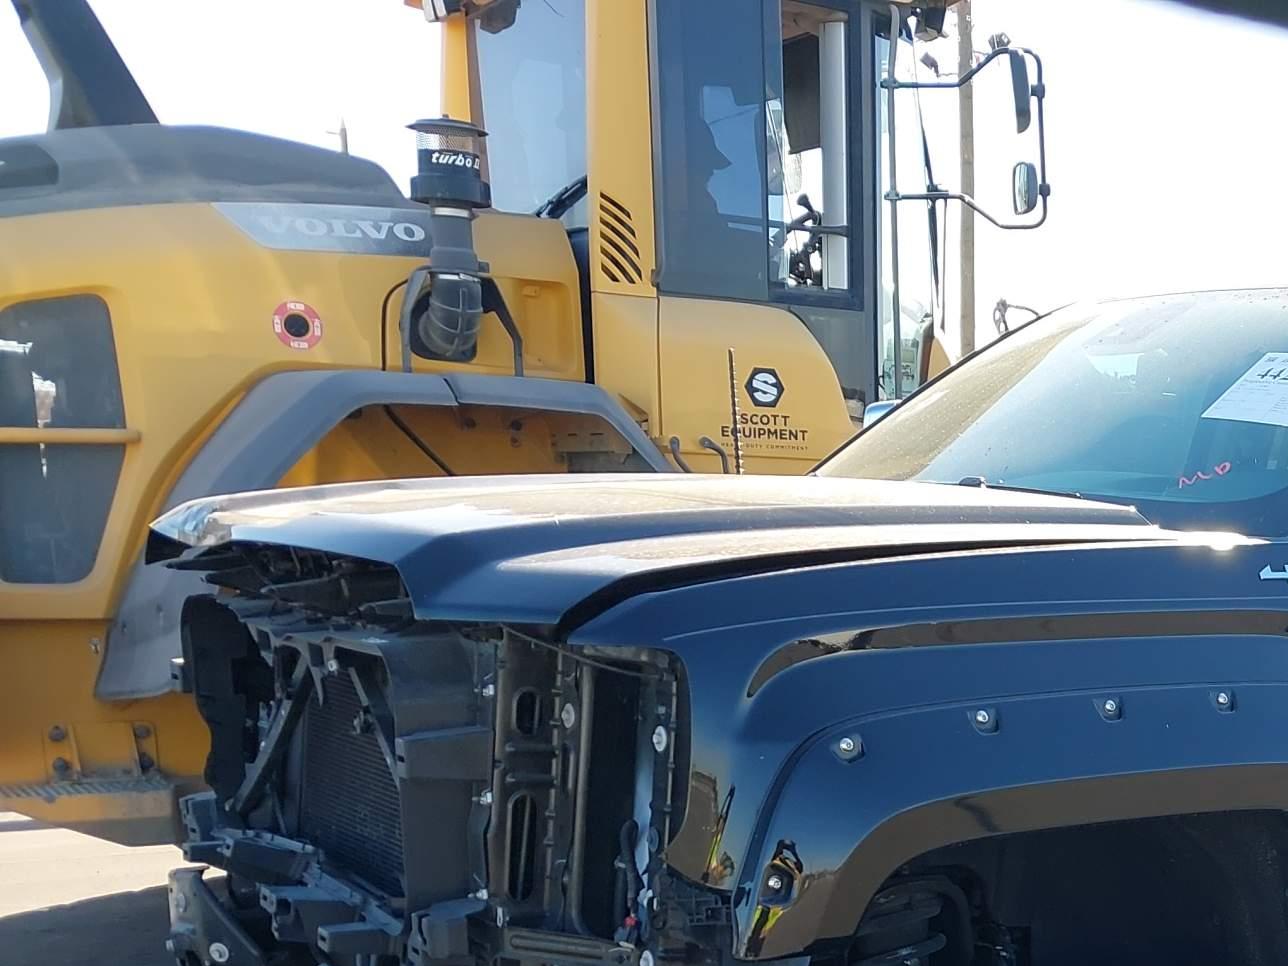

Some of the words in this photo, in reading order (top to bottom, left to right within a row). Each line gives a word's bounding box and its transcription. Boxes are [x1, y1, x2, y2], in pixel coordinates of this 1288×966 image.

[431, 151, 472, 168] turbo
[257, 214, 426, 242] VOLVO
[740, 413, 790, 427] SCOTT
